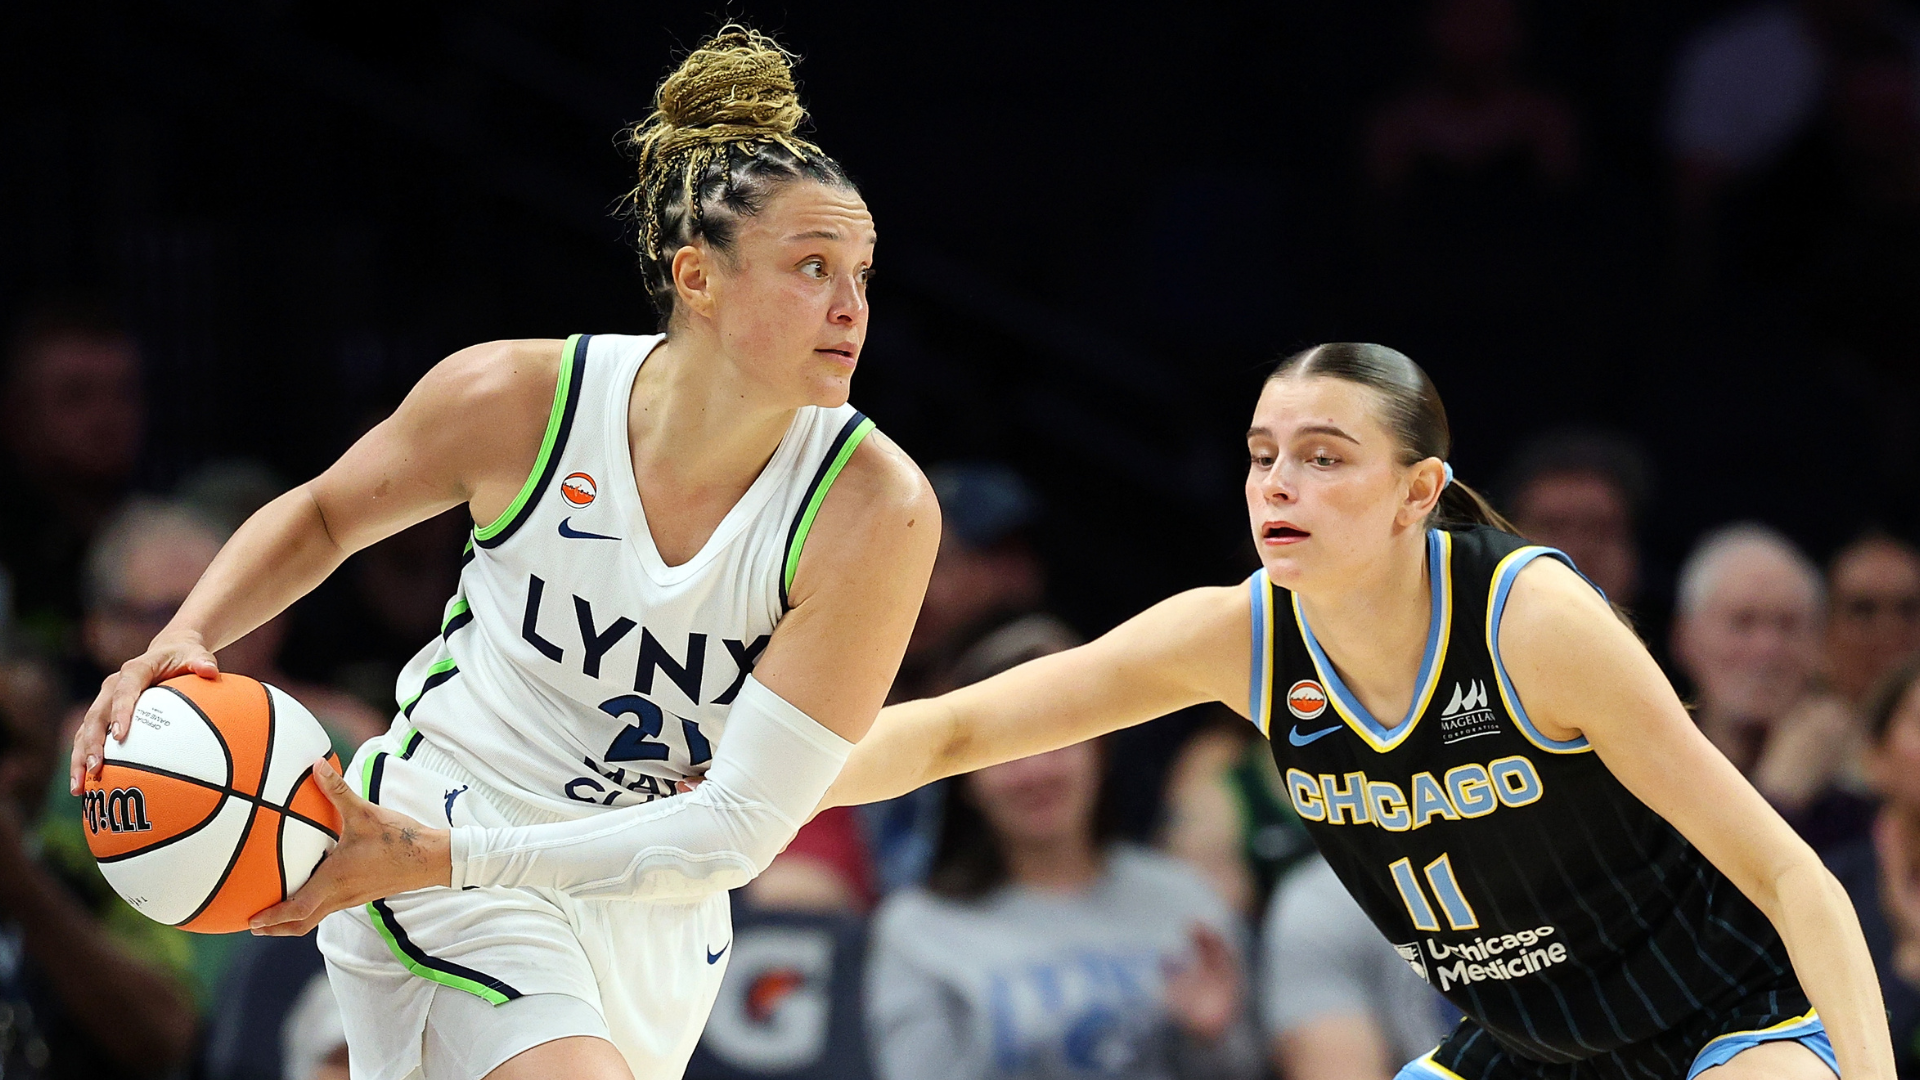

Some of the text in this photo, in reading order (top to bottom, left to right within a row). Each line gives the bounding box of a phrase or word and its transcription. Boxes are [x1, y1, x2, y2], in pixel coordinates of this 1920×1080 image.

[522, 573, 773, 706] LYNX
[135, 715, 162, 731] OFFICIAL
[150, 713, 171, 727] GAME
[598, 694, 713, 766] 21
[1442, 724, 1500, 740] CORPORATION
[1286, 755, 1544, 832] CHCAGO
[1388, 852, 1480, 932] 11
[1426, 926, 1555, 962] Uhicago
[1436, 941, 1568, 992] Medicine
